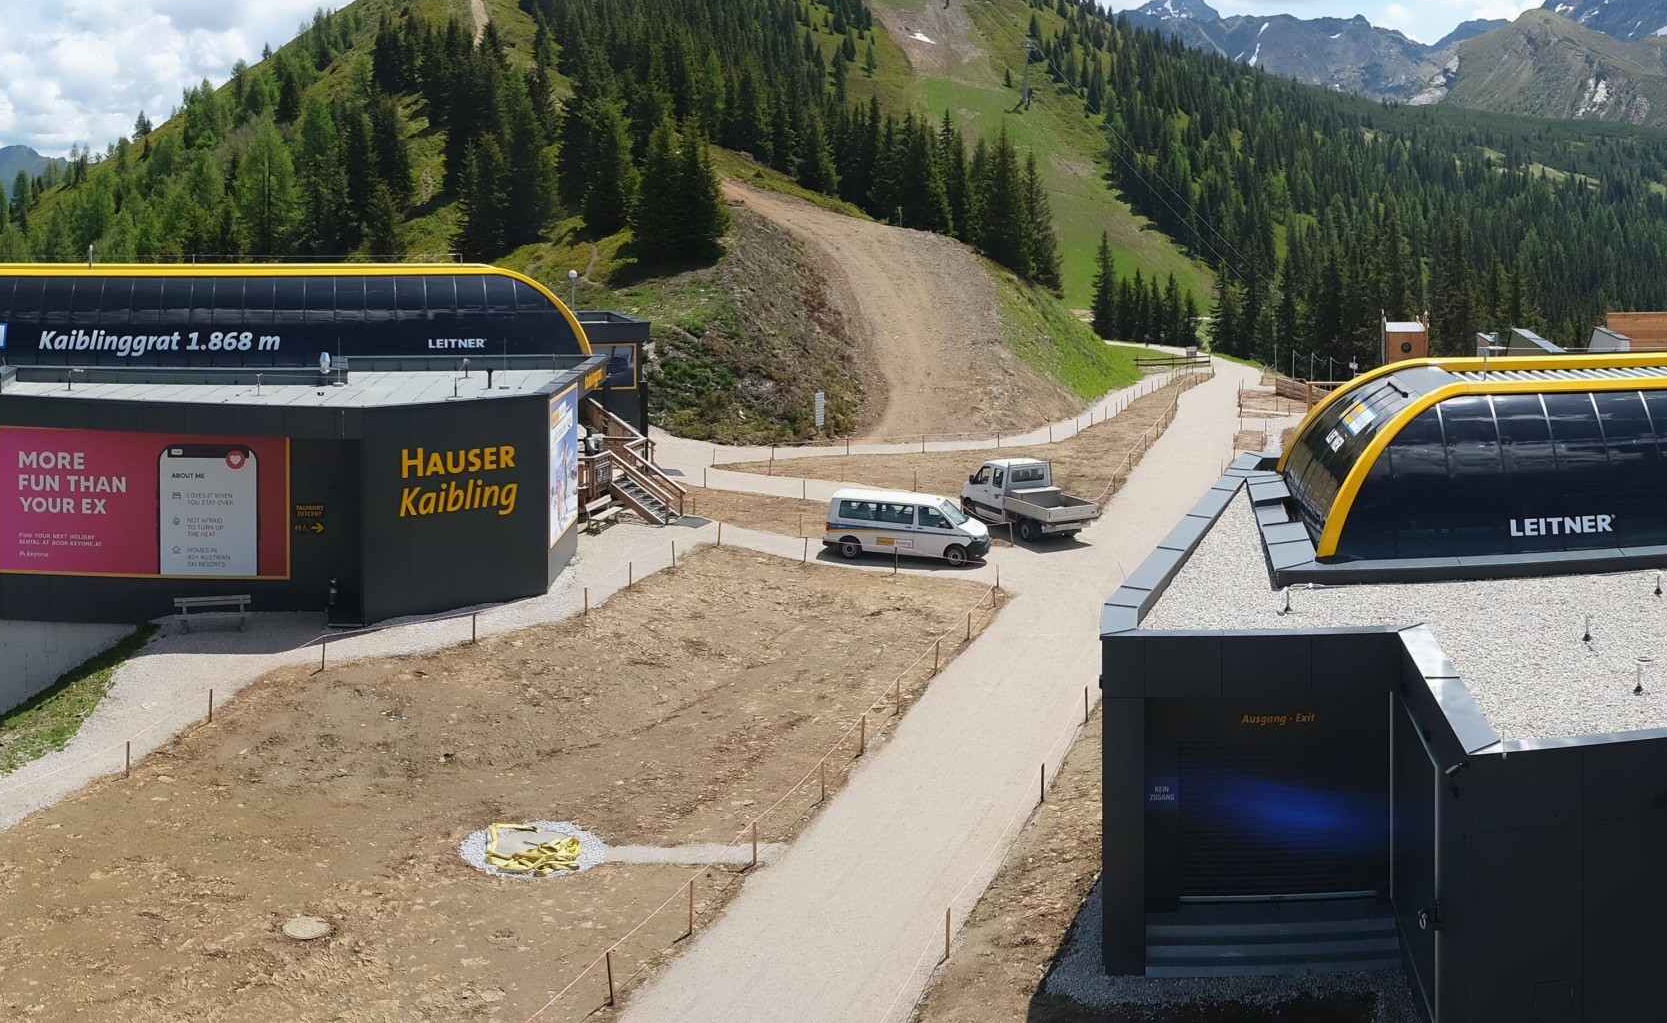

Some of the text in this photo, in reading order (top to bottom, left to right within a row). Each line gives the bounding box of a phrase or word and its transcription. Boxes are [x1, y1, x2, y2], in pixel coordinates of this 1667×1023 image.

[38, 330, 281, 357] Kaiblinggrat 1.868 m
[428, 338, 485, 348] LEITNER
[18, 451, 85, 470] MORE
[401, 445, 516, 479] HAUSER
[18, 474, 127, 493] FUN THAN
[19, 496, 107, 515] YOUR EX
[399, 479, 518, 517] Kaibling
[1510, 514, 1613, 537] LEITNER
[1241, 714, 1287, 726] Ausgang
[1295, 712, 1316, 722] Exit
